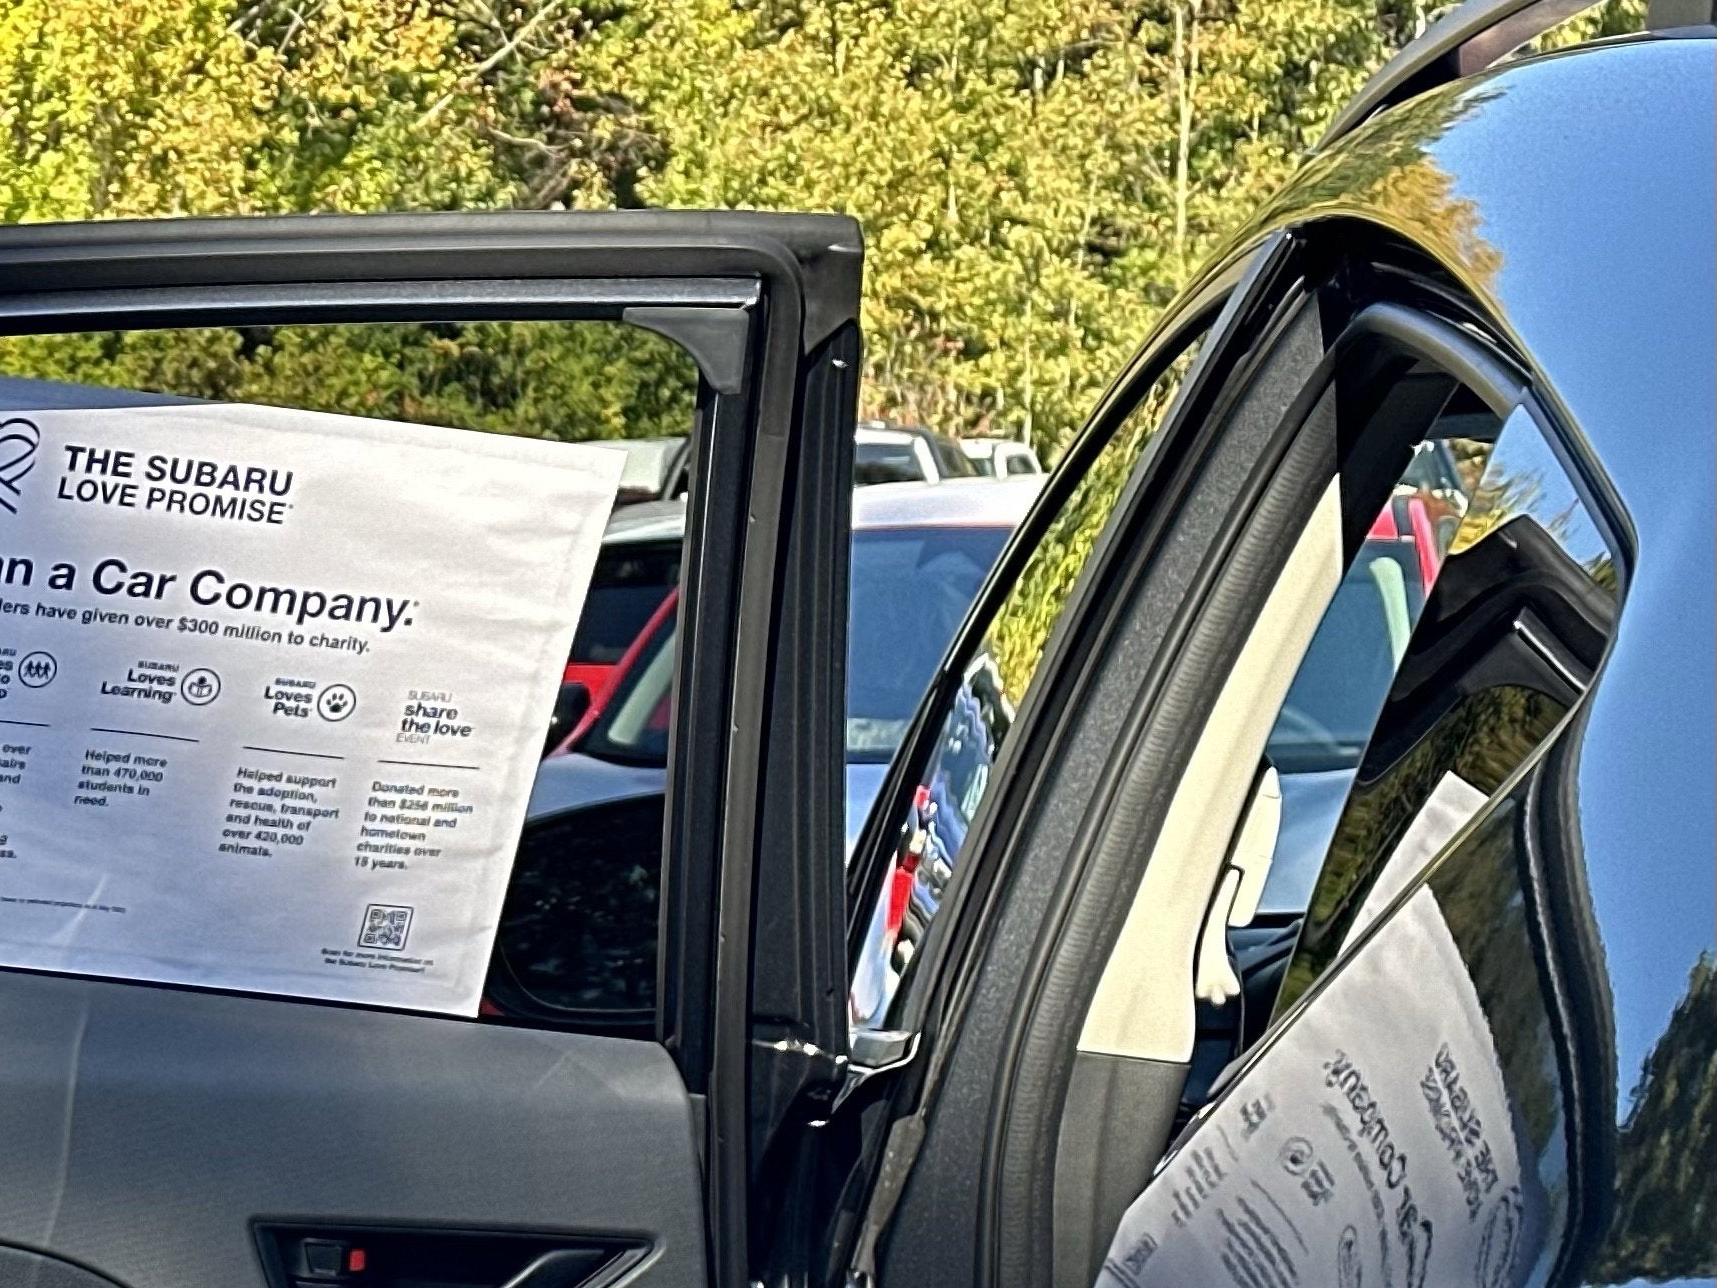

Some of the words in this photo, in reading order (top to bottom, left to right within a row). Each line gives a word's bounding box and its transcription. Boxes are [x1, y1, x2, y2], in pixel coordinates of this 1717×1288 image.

[64, 445, 136, 479] THE
[144, 455, 294, 497] SUBARU
[57, 476, 140, 508] LOVE
[48, 562, 77, 591] a
[92, 558, 177, 599] Car
[34, 603, 78, 620] have
[81, 610, 130, 625] given
[133, 616, 173, 630] over
[176, 622, 219, 636] $300
[222, 628, 283, 644] million
[287, 636, 305, 646] to
[308, 639, 370, 656] charity.
[138, 661, 179, 672] SUBARU
[127, 669, 176, 687] Loves
[275, 678, 316, 689] SUBARU
[101, 682, 176, 704] Learning
[264, 686, 312, 703] Loves
[408, 691, 452, 702] SUBARU
[273, 702, 308, 718] Pets
[404, 703, 458, 720] share
[401, 719, 431, 733] the
[433, 721, 472, 737] love
[396, 733, 430, 744] EVENT
[1, 744, 32, 755] over
[84, 749, 132, 765] Helped
[132, 755, 168, 768] more
[81, 764, 111, 777] than
[112, 766, 164, 783] 470,000
[236, 766, 284, 783] Helped
[285, 774, 338, 789] support
[77, 779, 135, 795] students
[136, 784, 150, 797] in
[233, 782, 255, 795] the
[256, 786, 318, 804] adoption,
[371, 780, 426, 796] Donated
[427, 787, 460, 799] more
[73, 795, 109, 807] need.
[229, 798, 277, 815] rescue,
[279, 803, 340, 820] transport
[367, 796, 397, 809] than
[430, 802, 474, 814] million
[225, 813, 252, 825] and
[253, 814, 294, 830] health
[296, 820, 312, 832] of
[363, 811, 378, 823] to
[379, 813, 432, 827] national
[432, 817, 458, 829] and
[222, 828, 253, 840] over
[253, 830, 305, 846] 420,000
[359, 824, 427, 842] hometown
[218, 842, 273, 858] animals.
[356, 840, 411, 856] charities
[413, 847, 442, 857] over
[370, 858, 408, 871] years.
